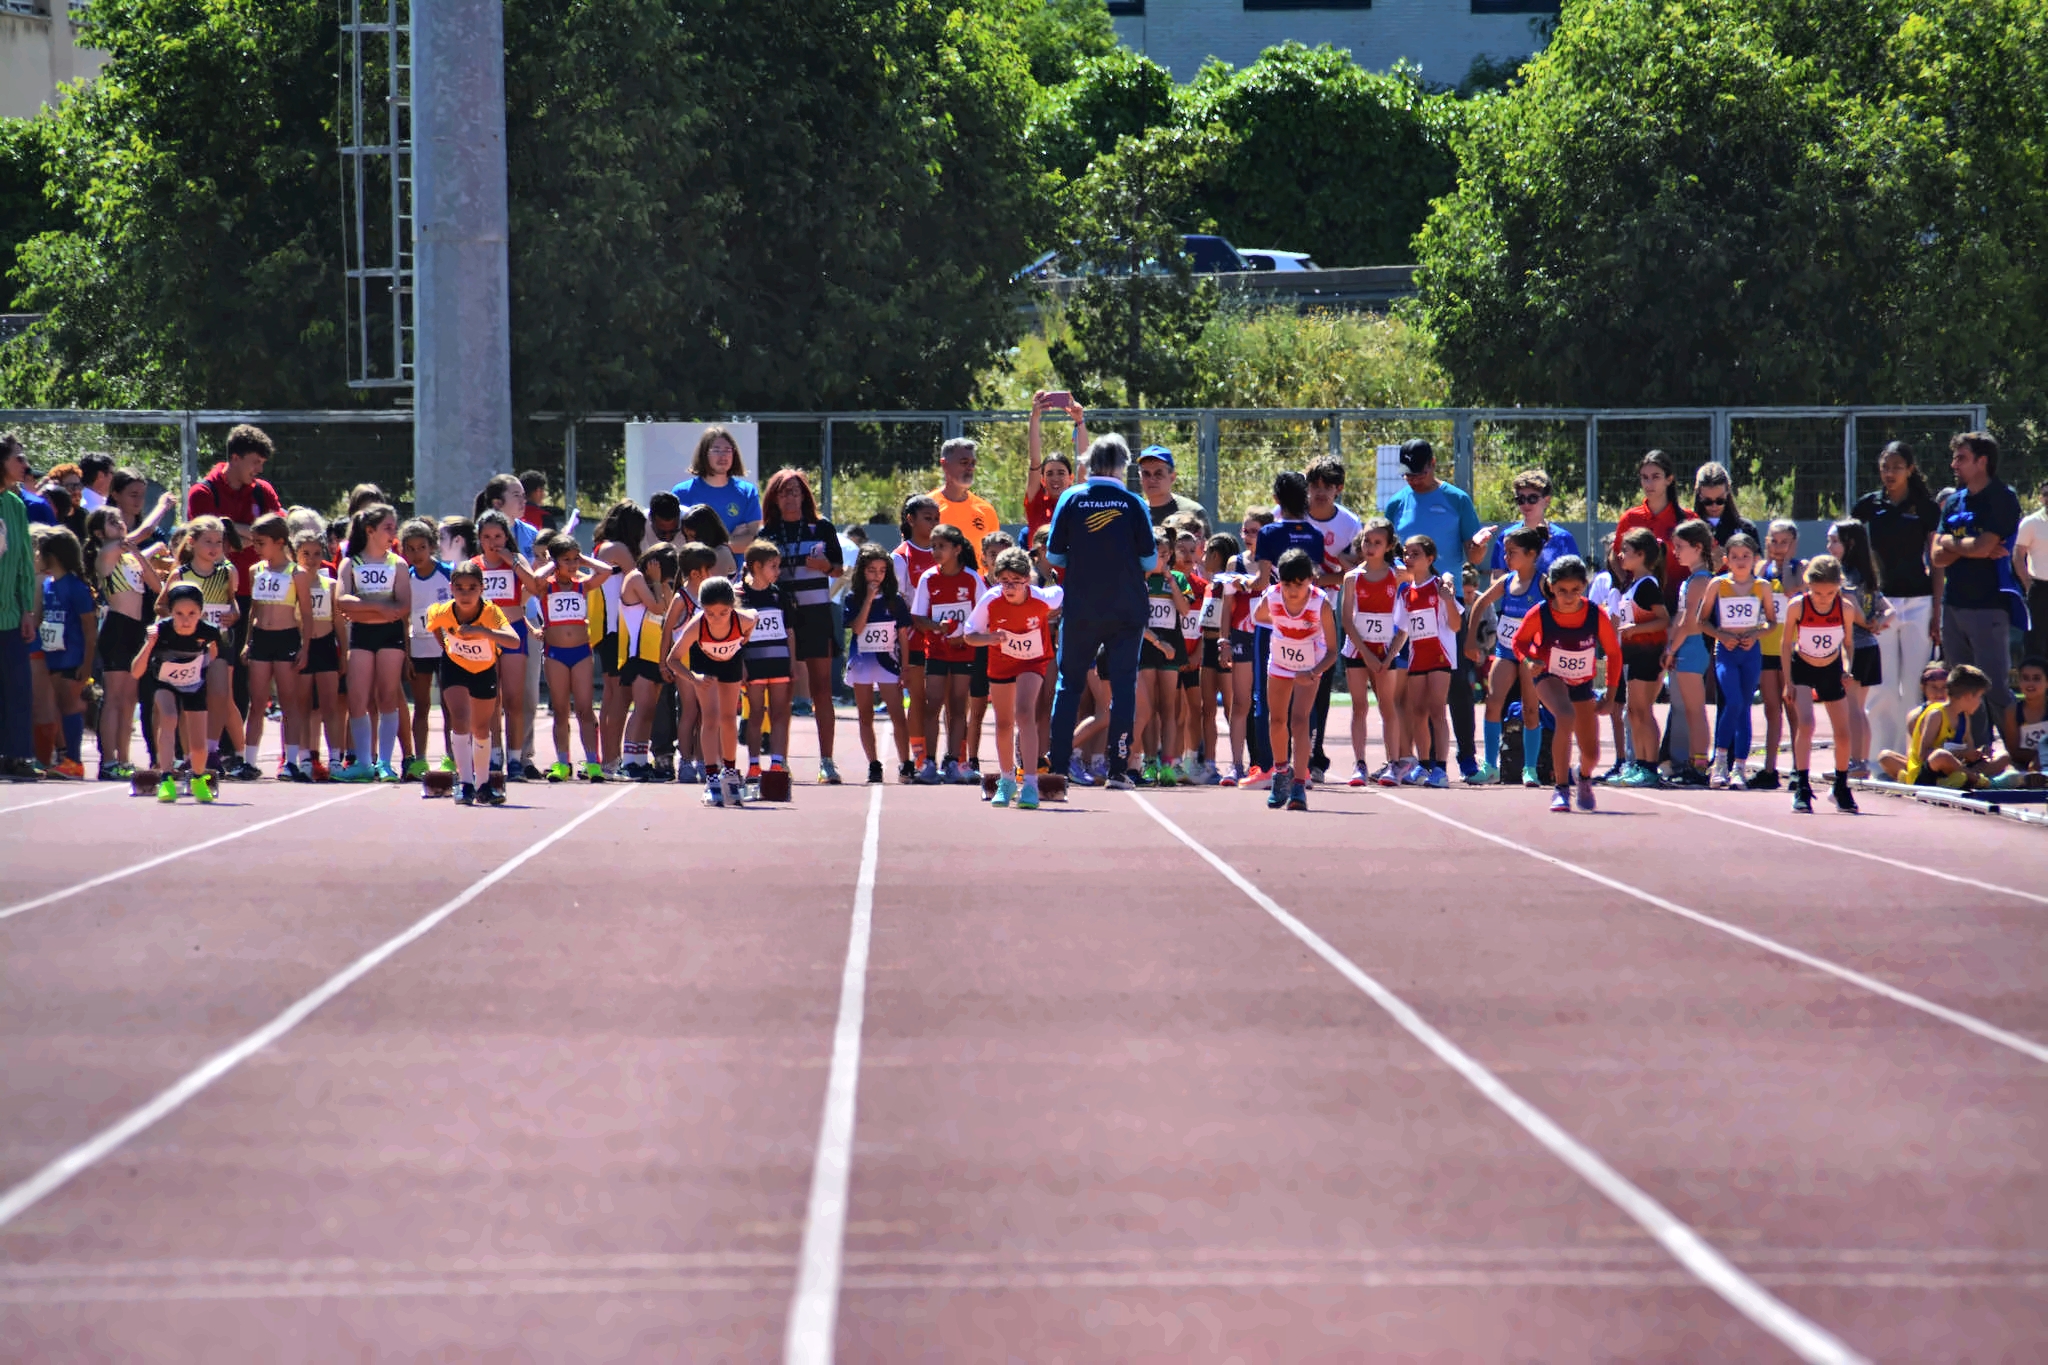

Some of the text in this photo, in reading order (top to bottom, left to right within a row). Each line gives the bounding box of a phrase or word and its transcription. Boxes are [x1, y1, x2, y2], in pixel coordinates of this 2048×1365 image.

[1078, 500, 1129, 508] CATALUNYA
[361, 570, 388, 584] 306
[258, 577, 280, 592] 316
[554, 598, 580, 612] 375
[1727, 603, 1753, 618] 398
[755, 616, 779, 631] 495
[1366, 619, 1383, 633] 75
[1410, 616, 1425, 633] 73
[864, 629, 889, 643] 693
[1501, 623, 1519, 639] 22
[1008, 639, 1032, 652] 419
[1812, 634, 1832, 649] 98
[712, 644, 736, 655] 107
[1280, 646, 1305, 662] 196
[1558, 656, 1586, 670] 585
[168, 666, 197, 680] 493
